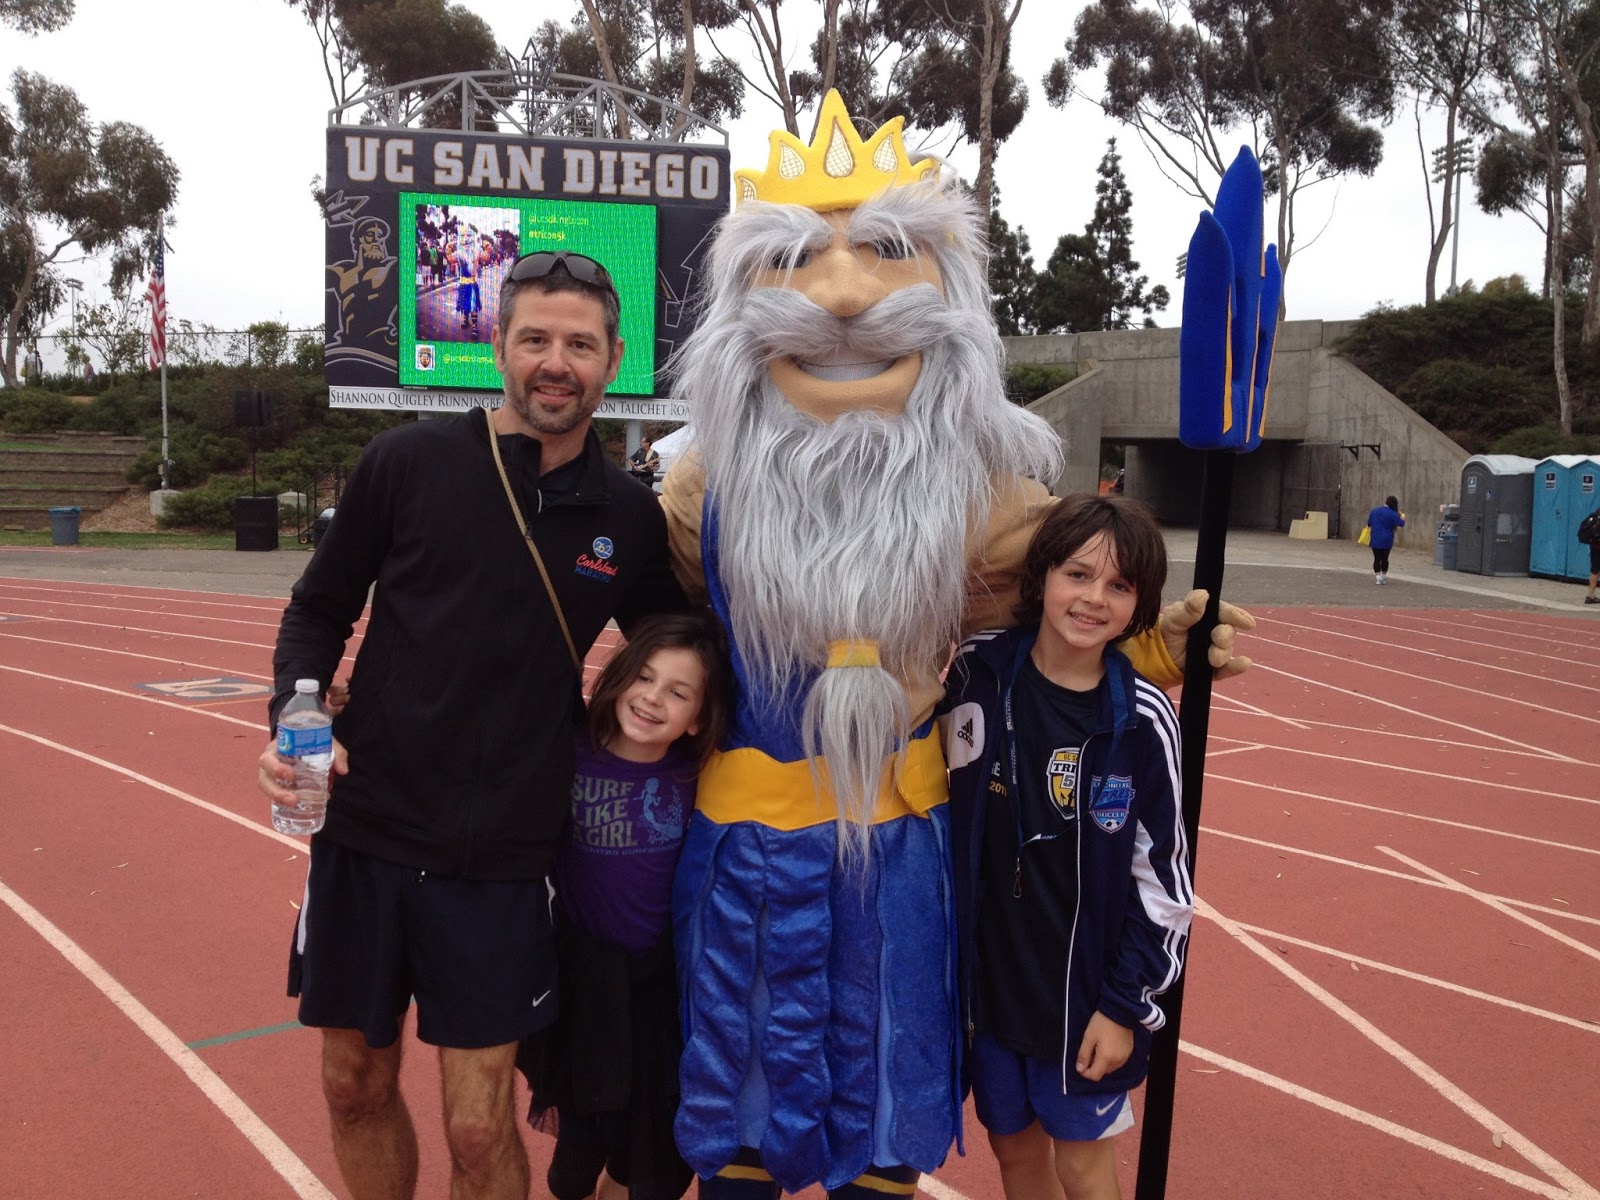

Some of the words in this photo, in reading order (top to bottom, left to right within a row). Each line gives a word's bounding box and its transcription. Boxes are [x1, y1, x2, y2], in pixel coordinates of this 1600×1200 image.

[345, 135, 414, 183] UC
[434, 141, 545, 191] SAN
[563, 147, 720, 199] DIEGO
[330, 389, 385, 405] SHANNON
[388, 391, 436, 408] QUIGLEY
[620, 400, 668, 416] TALICHET
[570, 773, 635, 803] SURF
[571, 799, 629, 828] LIKE
[585, 820, 638, 848] GIRL
